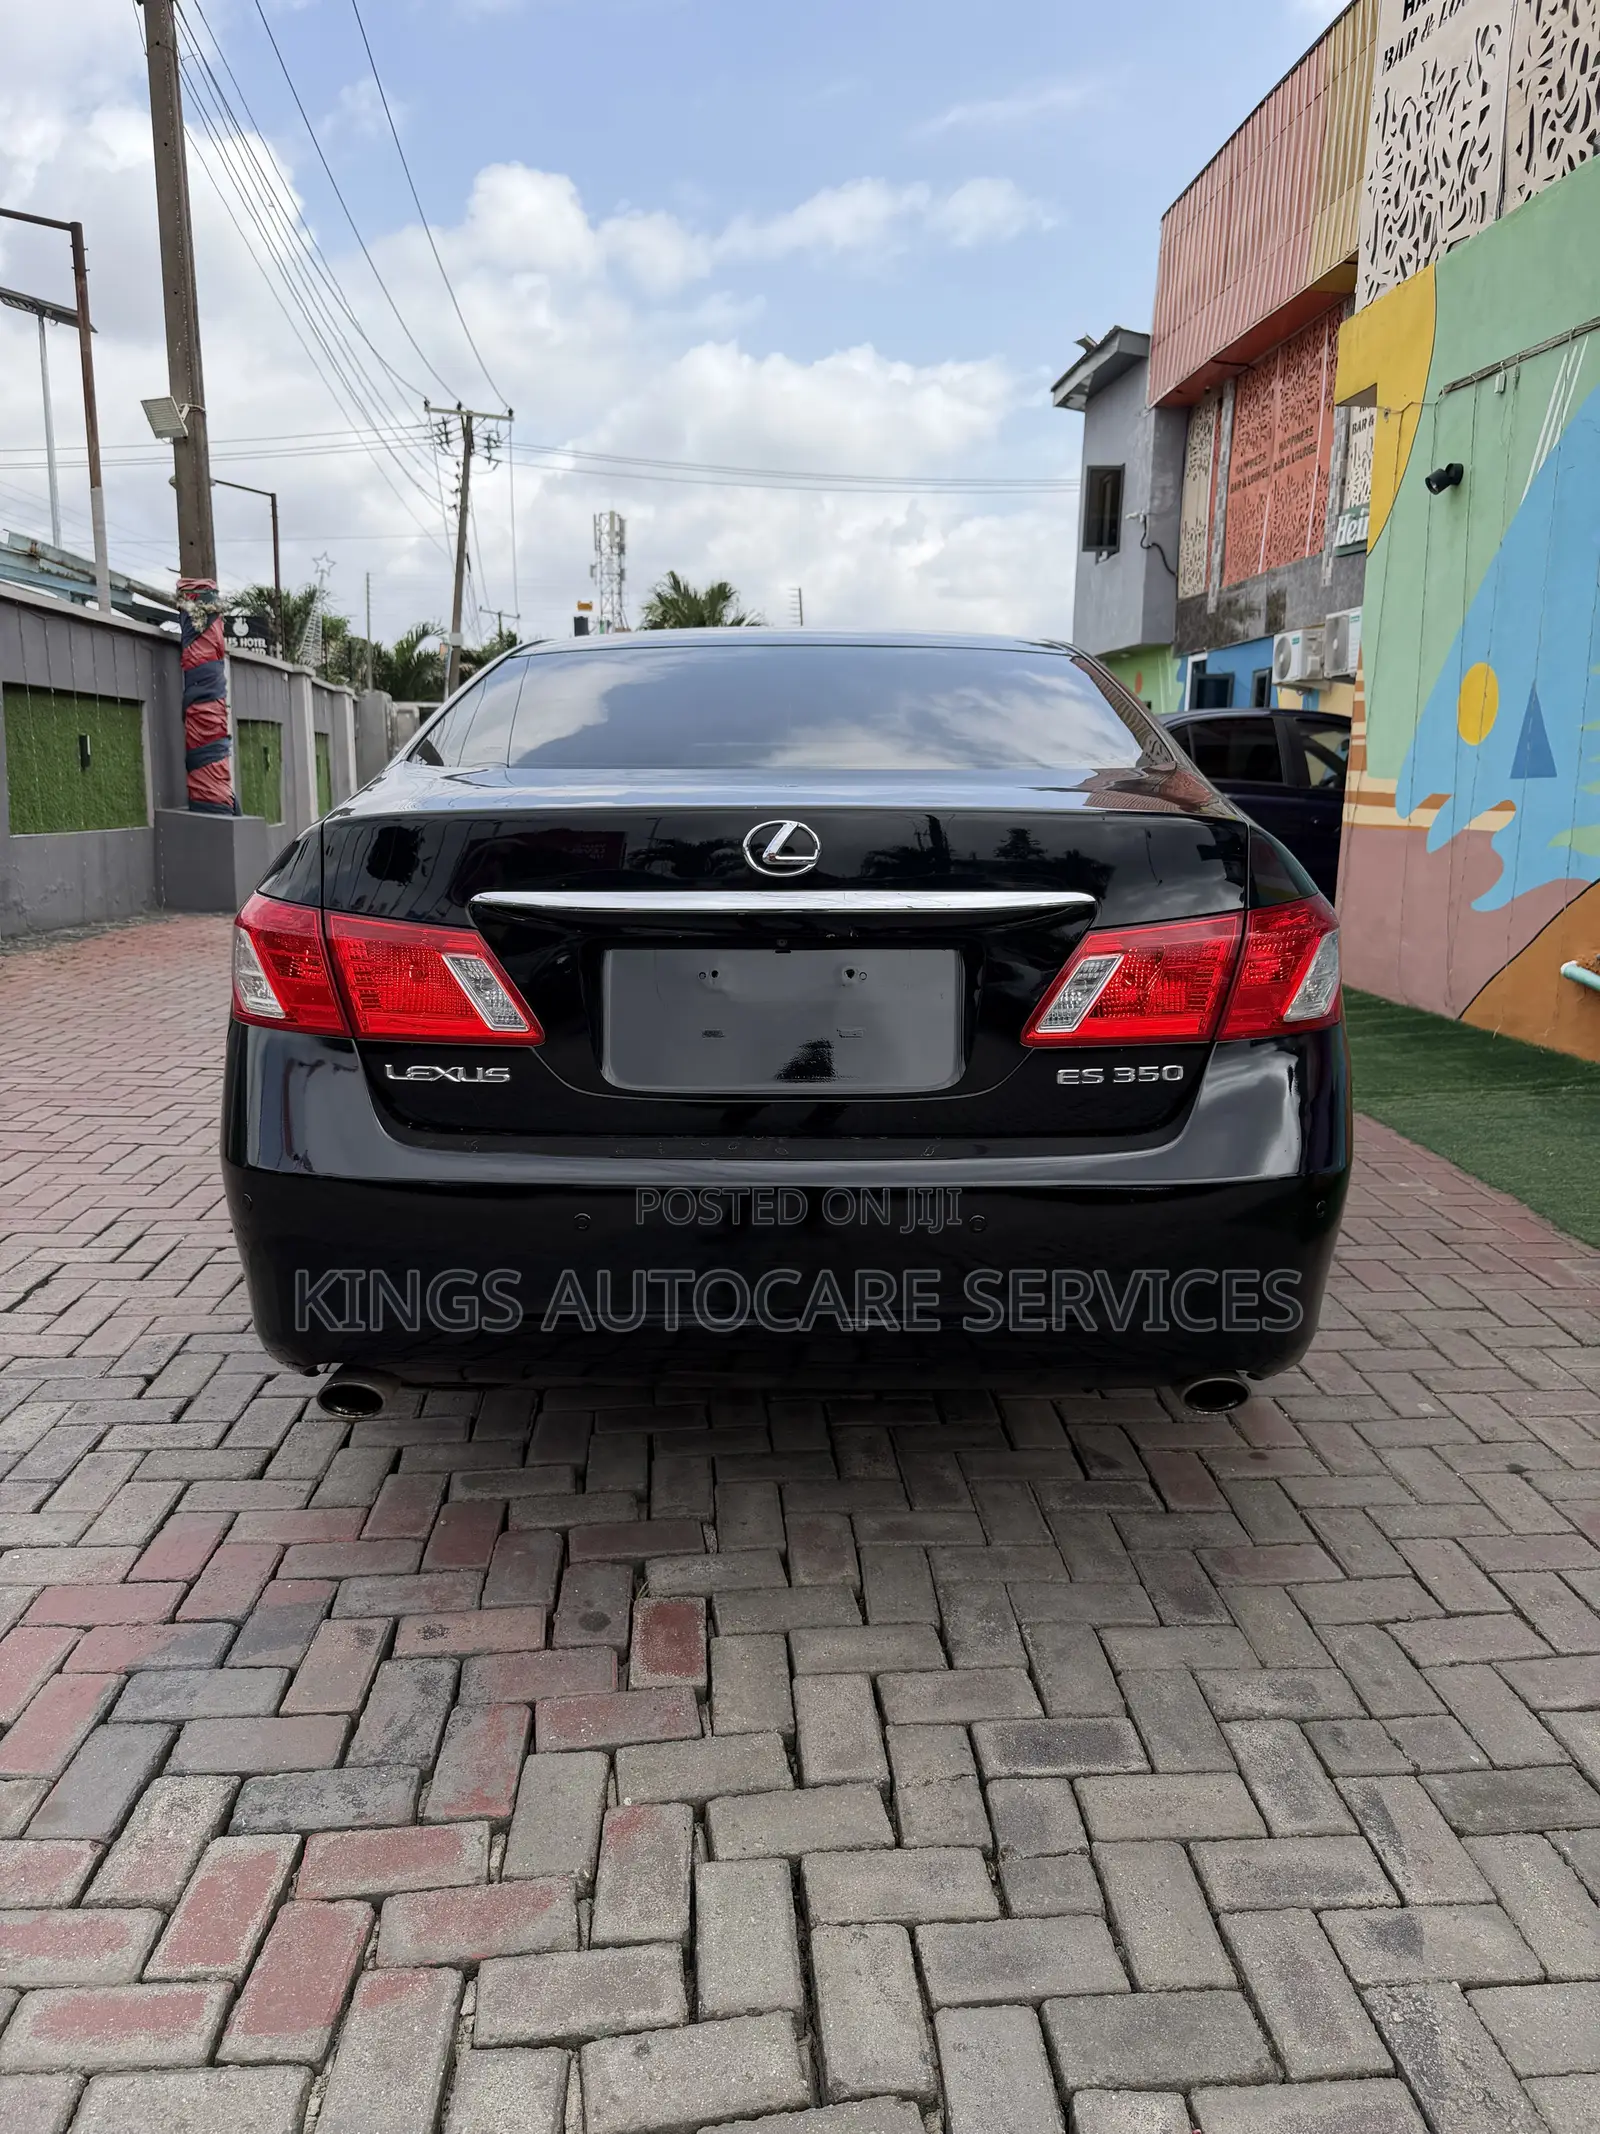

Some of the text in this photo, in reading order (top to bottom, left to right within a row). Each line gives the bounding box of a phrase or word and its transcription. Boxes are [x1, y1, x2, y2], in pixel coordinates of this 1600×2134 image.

[1382, 26, 1418, 76] BAR
[1352, 418, 1367, 435] BAR
[240, 637, 267, 648] HOTEL
[384, 1064, 510, 1083] LEXUS
[1057, 1064, 1184, 1085] ES 350
